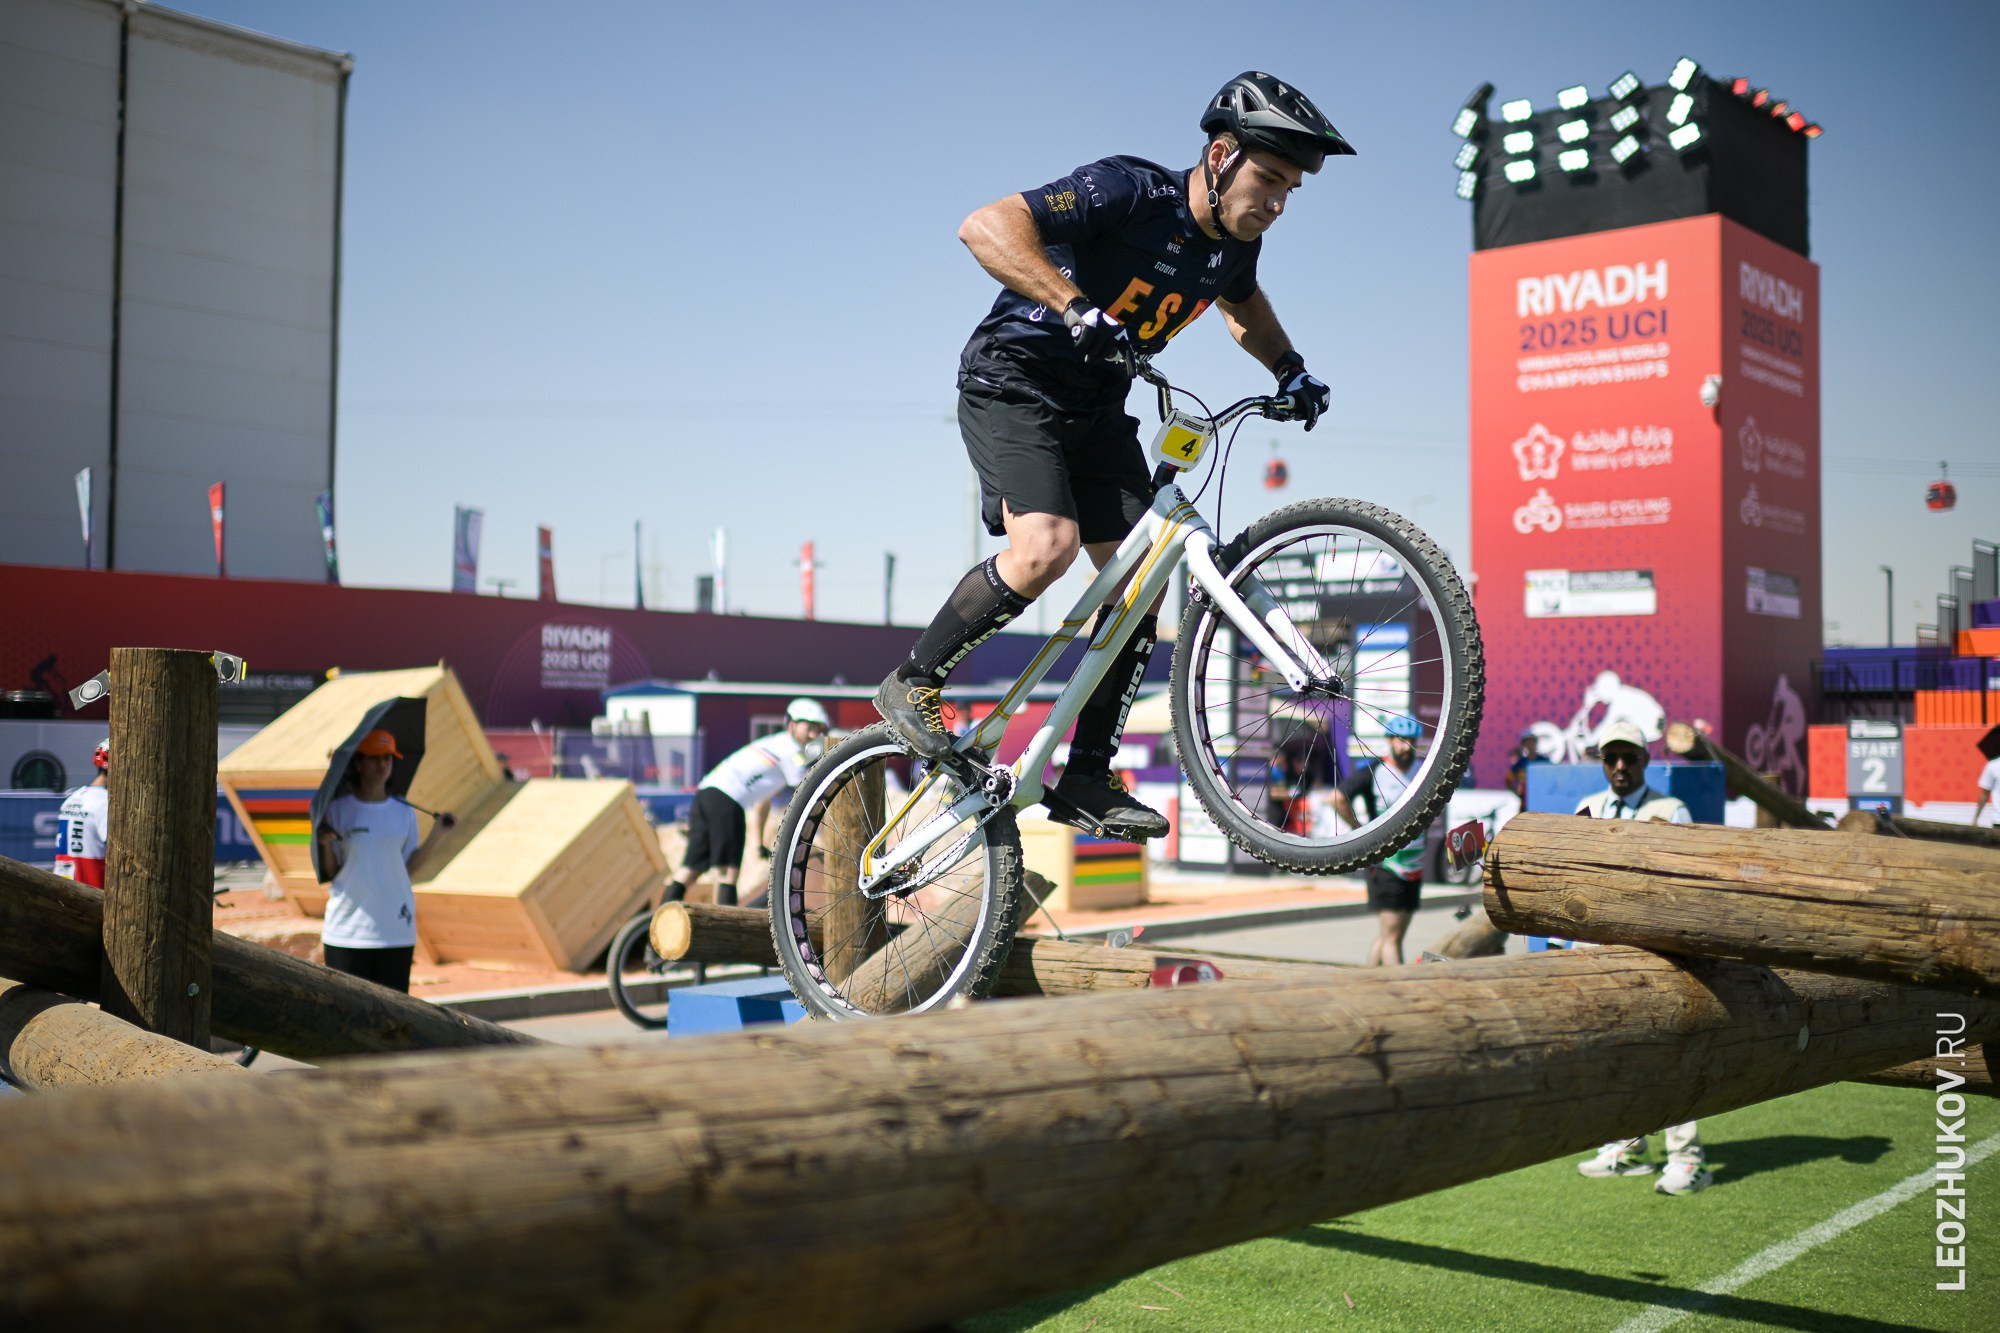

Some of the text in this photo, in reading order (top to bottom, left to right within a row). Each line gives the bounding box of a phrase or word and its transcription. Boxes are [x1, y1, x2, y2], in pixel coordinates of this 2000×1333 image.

[1045, 191, 1076, 212] ESP
[1166, 242, 1181, 254] RFEC
[1154, 261, 1177, 276] GOBIK
[1517, 259, 1668, 318] RIYADH
[1740, 260, 1804, 324] RIYADH
[1520, 307, 1667, 351] 2025 UCI
[1742, 308, 1803, 357] 2025 UCI
[1517, 359, 1669, 393] CHAMPIONSHIPS
[1180, 438, 1197, 457] 4
[542, 624, 610, 650] RIYADH
[543, 650, 610, 670] 2025 UCI
[1110, 661, 1145, 748] hebo
[1851, 741, 1898, 758] START
[1862, 757, 1888, 793] 2
[71, 820, 84, 853] CHI
